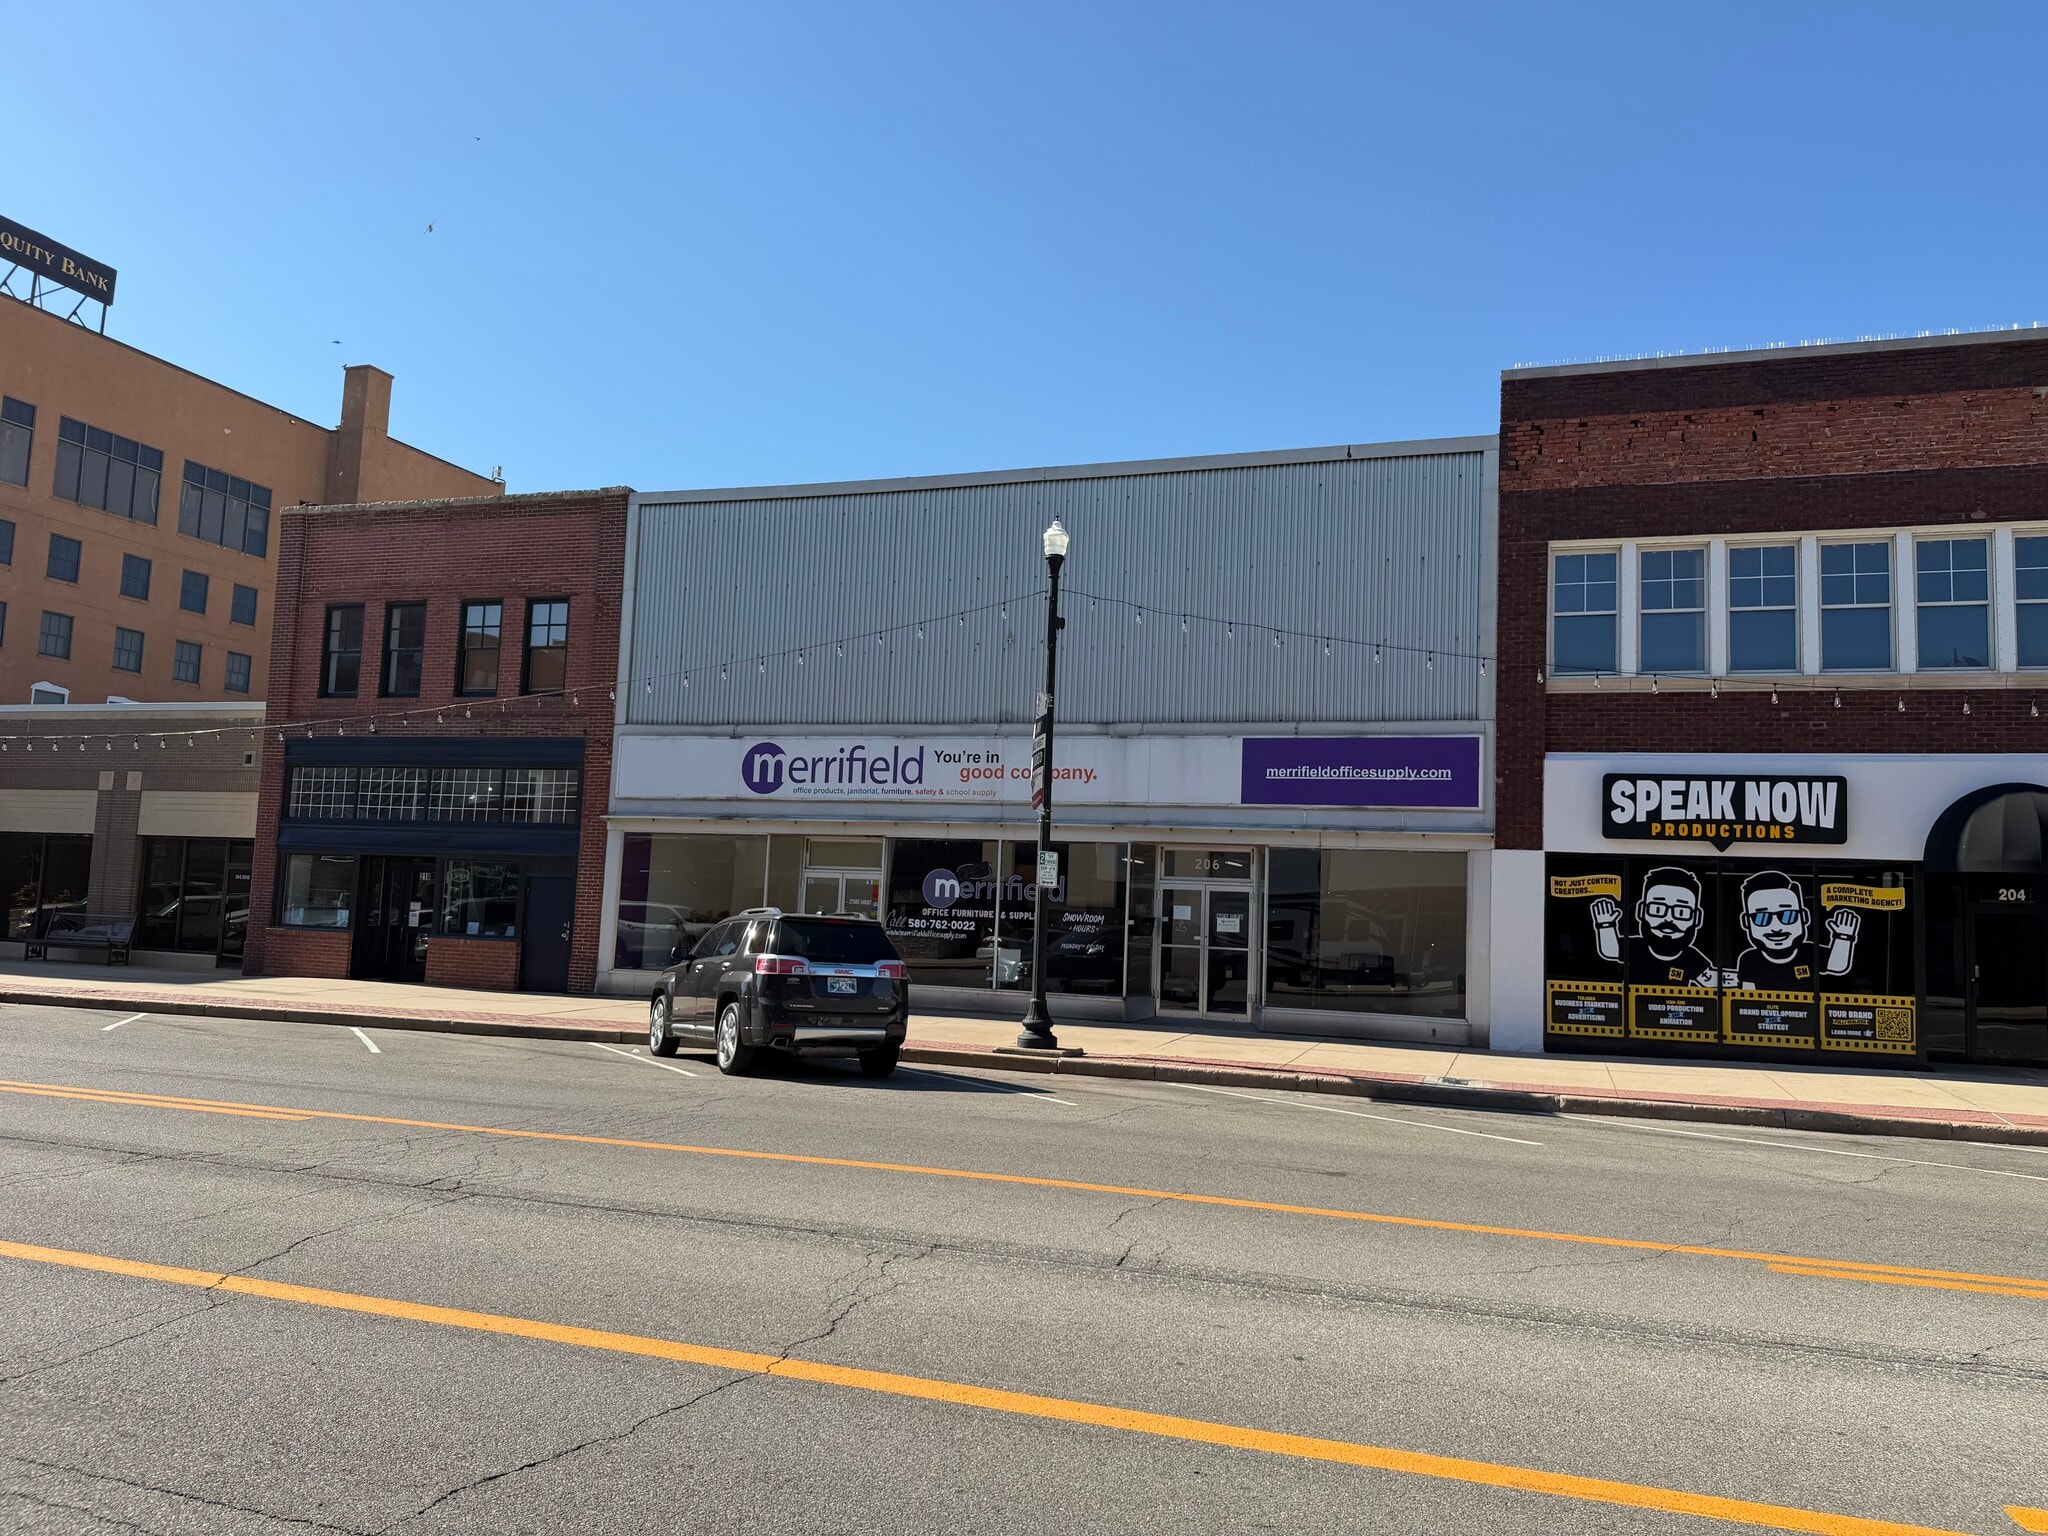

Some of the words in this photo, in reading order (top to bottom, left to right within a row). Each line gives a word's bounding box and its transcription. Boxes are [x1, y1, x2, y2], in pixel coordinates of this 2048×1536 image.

[0, 232, 56, 266] QUITY
[61, 257, 109, 292] BANK
[750, 744, 925, 785] merrifield
[986, 750, 1000, 764] in
[960, 764, 1005, 783] good
[1011, 767, 1098, 784] copany.
[1266, 766, 1452, 781] merrifieldofficesupply.com
[793, 786, 812, 794] office
[814, 787, 846, 795] products,
[847, 787, 880, 795] janitorial,
[881, 787, 914, 795] furniture,
[915, 788, 937, 796] safety
[938, 788, 944, 796] &
[946, 788, 971, 796] school
[972, 789, 997, 797] supply
[1610, 779, 1737, 825] SPEAK
[1744, 780, 1838, 829] NOW
[1651, 822, 1796, 839] PRODUCTIONS
[1194, 859, 1220, 870] 206
[1554, 879, 1567, 887] NOT
[1568, 879, 1586, 887] JUST
[1587, 877, 1618, 885] CONTENT
[931, 874, 1066, 903] merrified
[1826, 886, 1831, 894] A
[1832, 886, 1874, 897] COMPLETE
[1998, 888, 2026, 901] 204
[1826, 895, 1870, 905] MARKETING
[1871, 898, 1902, 907] AGENCY!
[885, 909, 907, 930] Call
[922, 908, 949, 917] OFFICE
[951, 908, 994, 918] FURNITURE
[1000, 911, 1006, 919] &
[1008, 911, 1036, 920] SUPPL
[1062, 912, 1105, 925] SHOWROOM
[1072, 924, 1096, 933] HOURS
[1670, 970, 1682, 979] SN
[1796, 967, 1808, 977] SN
[1554, 999, 1583, 1007] BUSINESS
[1584, 1001, 1619, 1009] MARKETING
[1666, 1005, 1704, 1013] PRODUCTION
[1567, 1013, 1606, 1021] ADVERTISING
[1739, 1008, 1760, 1016] BRAND
[1760, 1009, 1808, 1018] DEVELOPMENT
[1828, 1009, 1847, 1018] YOUR
[1848, 1010, 1873, 1019] BRAND
[1659, 1018, 1693, 1026] ANIMATION
[1757, 1023, 1789, 1031] STRATEGY
